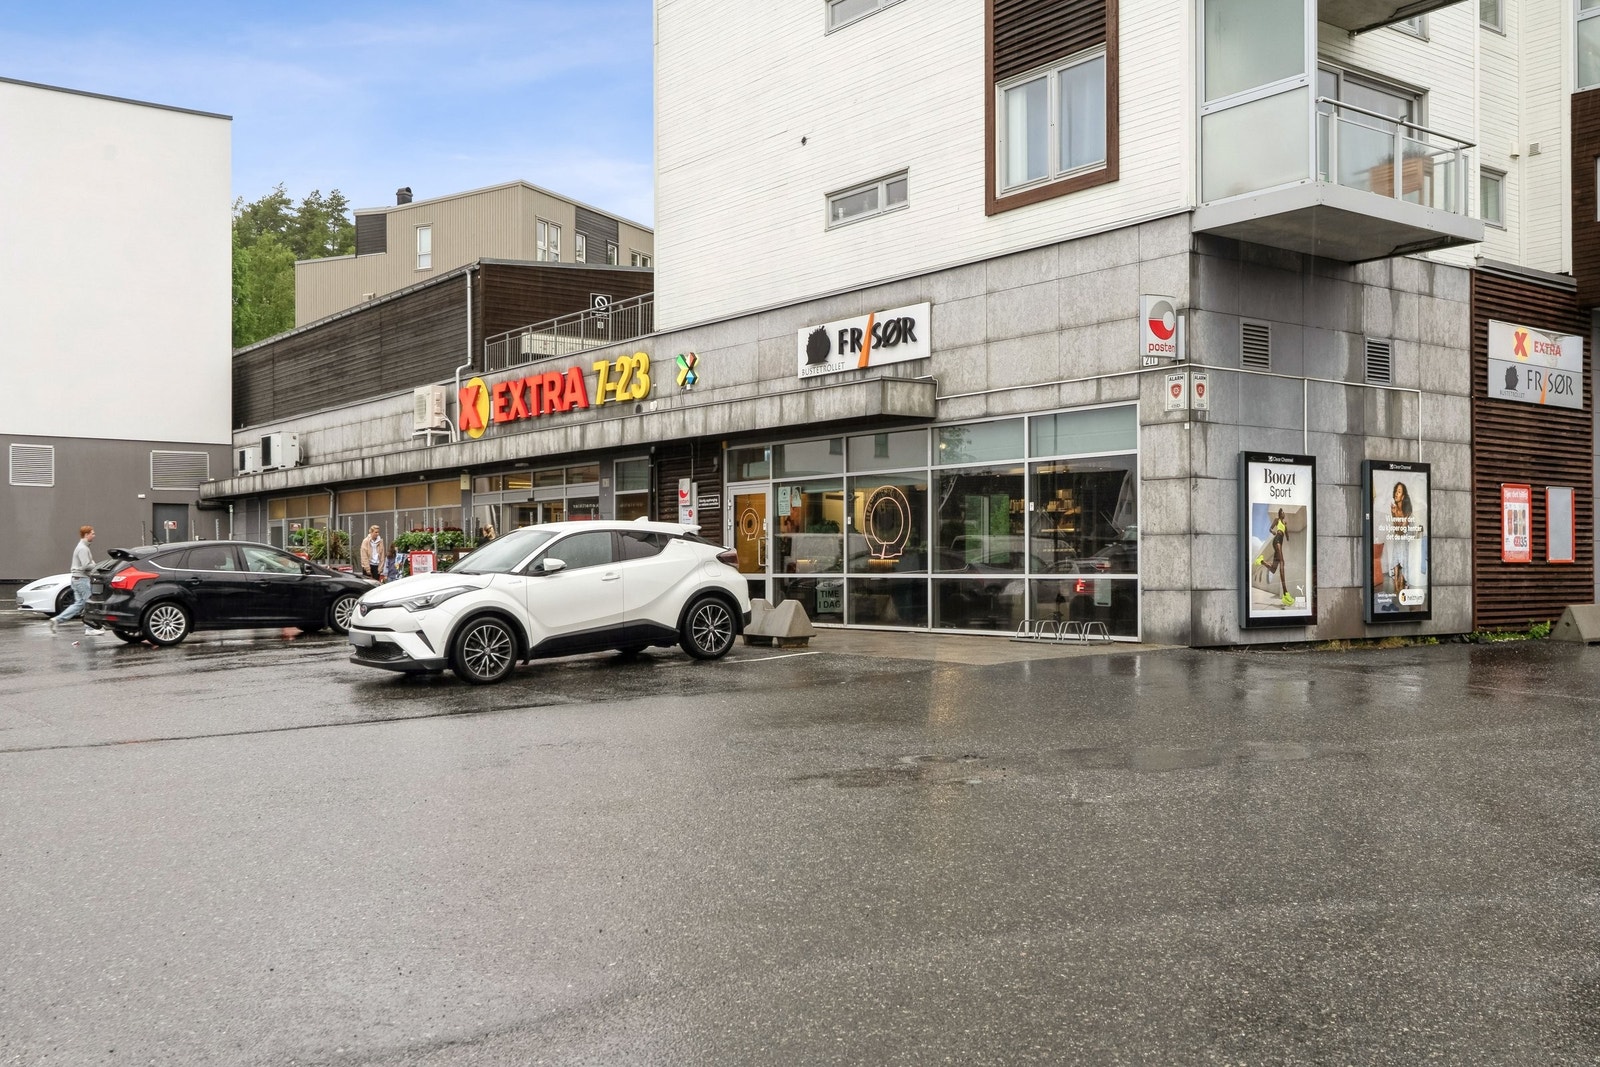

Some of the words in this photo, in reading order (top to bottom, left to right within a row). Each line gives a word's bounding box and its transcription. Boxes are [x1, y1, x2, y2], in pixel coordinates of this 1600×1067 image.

[1533, 340, 1562, 357] EXTRA
[801, 361, 845, 376] BUSTETROLLET
[492, 366, 589, 423] EXTRA
[592, 352, 650, 405] 7-23
[1264, 468, 1296, 485] Boozt
[1270, 485, 1291, 499] Sport
[820, 590, 840, 598] TIME
[823, 600, 841, 609] DAG
